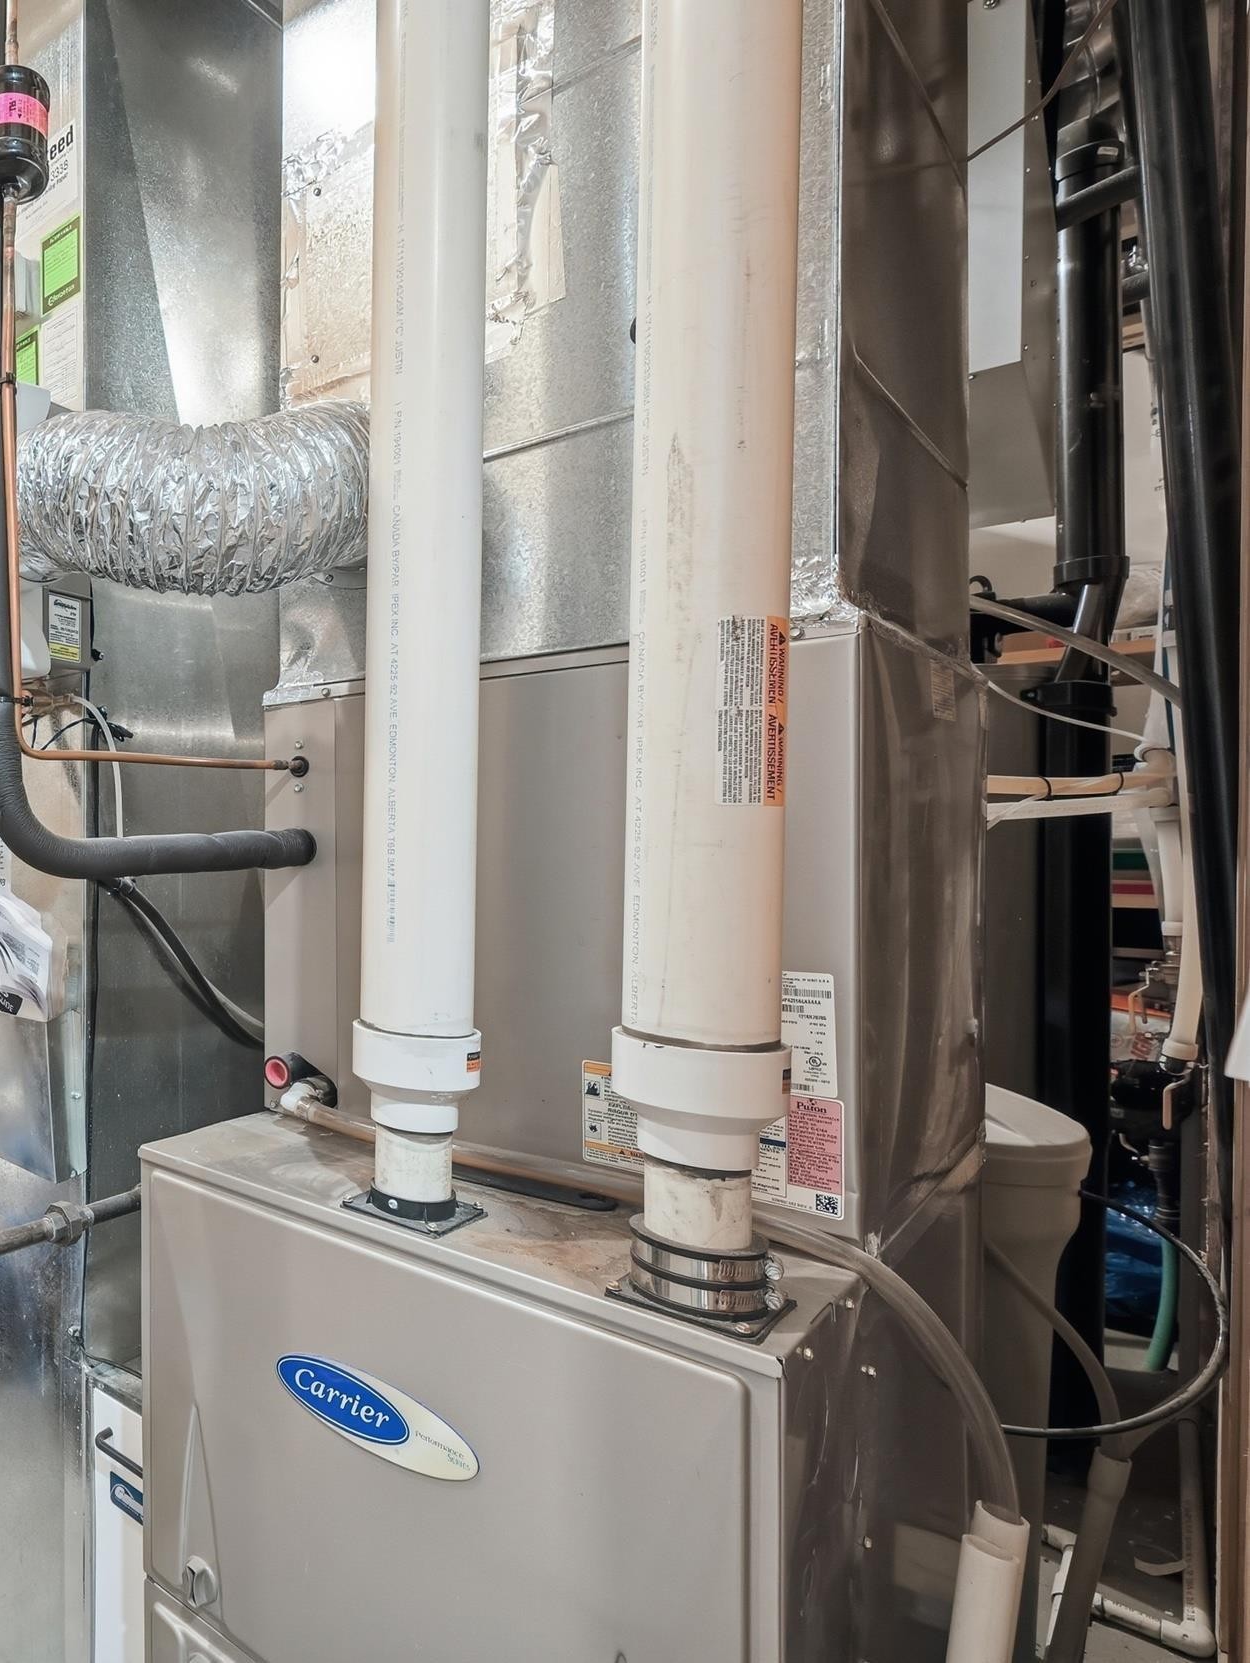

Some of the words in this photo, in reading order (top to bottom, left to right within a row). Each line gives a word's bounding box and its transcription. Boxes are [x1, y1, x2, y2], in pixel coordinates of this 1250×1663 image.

[49, 124, 75, 161] eed
[391, 504, 402, 548] CANADA
[390, 592, 400, 616] IPEX
[389, 642, 399, 656] AT
[637, 631, 647, 682] CANADA
[768, 623, 779, 706] AVERTISSEMEN
[777, 647, 787, 697] WARNING
[635, 736, 645, 763] IPEX
[767, 713, 778, 800] AVERTISSEMENT
[776, 737, 785, 786] WARNING
[387, 787, 397, 834] ALBERTA
[634, 795, 643, 811] AT
[630, 969, 640, 1026] ALBERTA
[294, 1367, 390, 1429] Carrier
[415, 1430, 464, 1459] Performance
